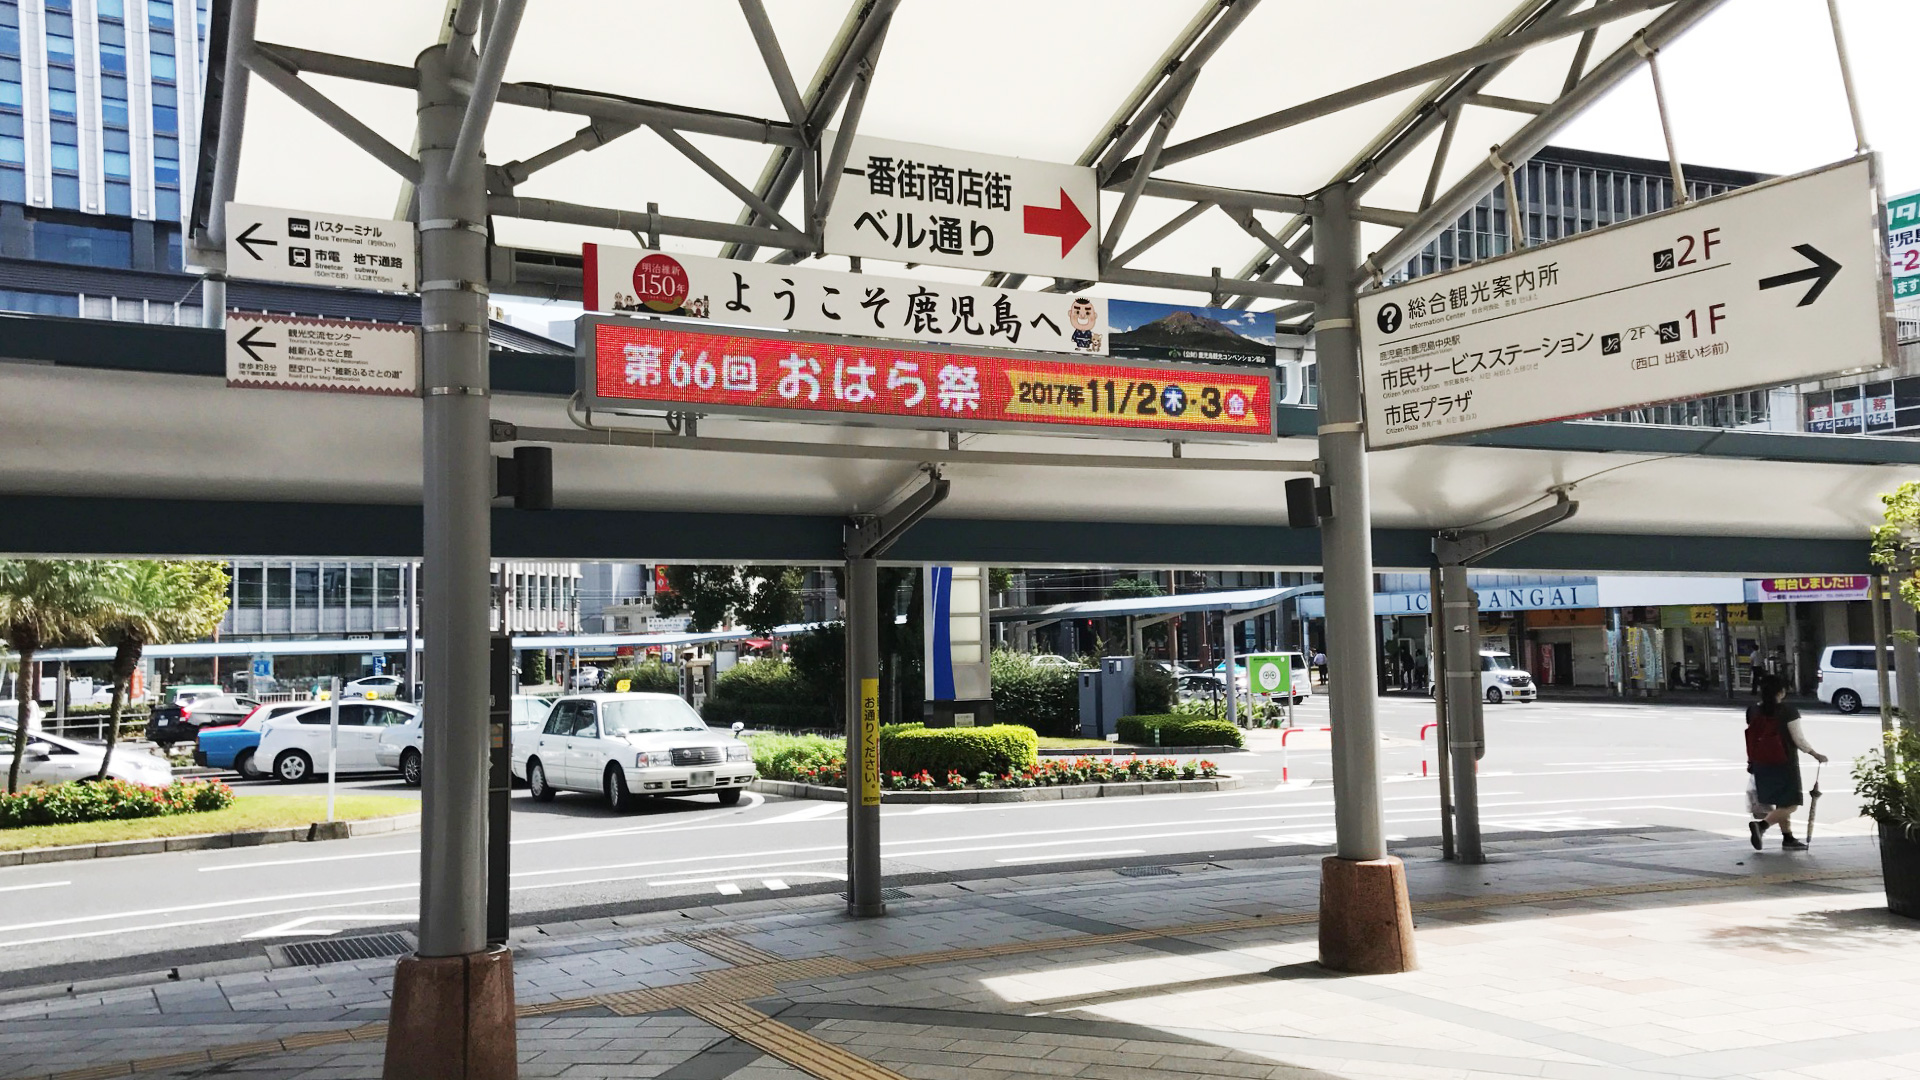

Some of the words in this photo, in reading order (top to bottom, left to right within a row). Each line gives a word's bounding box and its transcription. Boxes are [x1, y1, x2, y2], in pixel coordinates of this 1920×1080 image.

[843, 156, 1012, 212] 一番街商店街
[314, 221, 382, 238] バスターミナル
[332, 236, 363, 245] Terminal
[853, 209, 994, 257] ベル通り
[314, 249, 341, 262] 市電
[353, 253, 403, 269] 地下通路
[1676, 227, 1720, 267] 2F
[315, 262, 344, 271] Streetcar
[354, 267, 378, 275] subway
[641, 262, 681, 277] 明治維新
[637, 273, 686, 297] 150年
[1408, 262, 1559, 320] 総合観光案内所
[725, 272, 1062, 344] ようこそ鹿児島へ
[1684, 302, 1726, 338] 1F
[1409, 317, 1445, 330] Information
[1445, 311, 1466, 322] Center
[288, 328, 361, 341] 観光交流センター
[1630, 327, 1646, 340] 2F
[288, 346, 353, 359] 維新ふるさと館
[1379, 334, 1461, 361] 鹿児島市鹿児島中央駅
[1381, 332, 1594, 391] 市民サービスステーション
[623, 342, 758, 392] 第66回
[778, 353, 980, 412] おはら祭
[1382, 389, 1400, 399] Citizen
[1401, 386, 1420, 396] Service
[1420, 382, 1441, 392] Station
[1384, 390, 1473, 426] 市民プラザ
[1385, 425, 1404, 435] Citizen
[1405, 424, 1419, 432] Plaza
[864, 697, 876, 789] お通りください。
